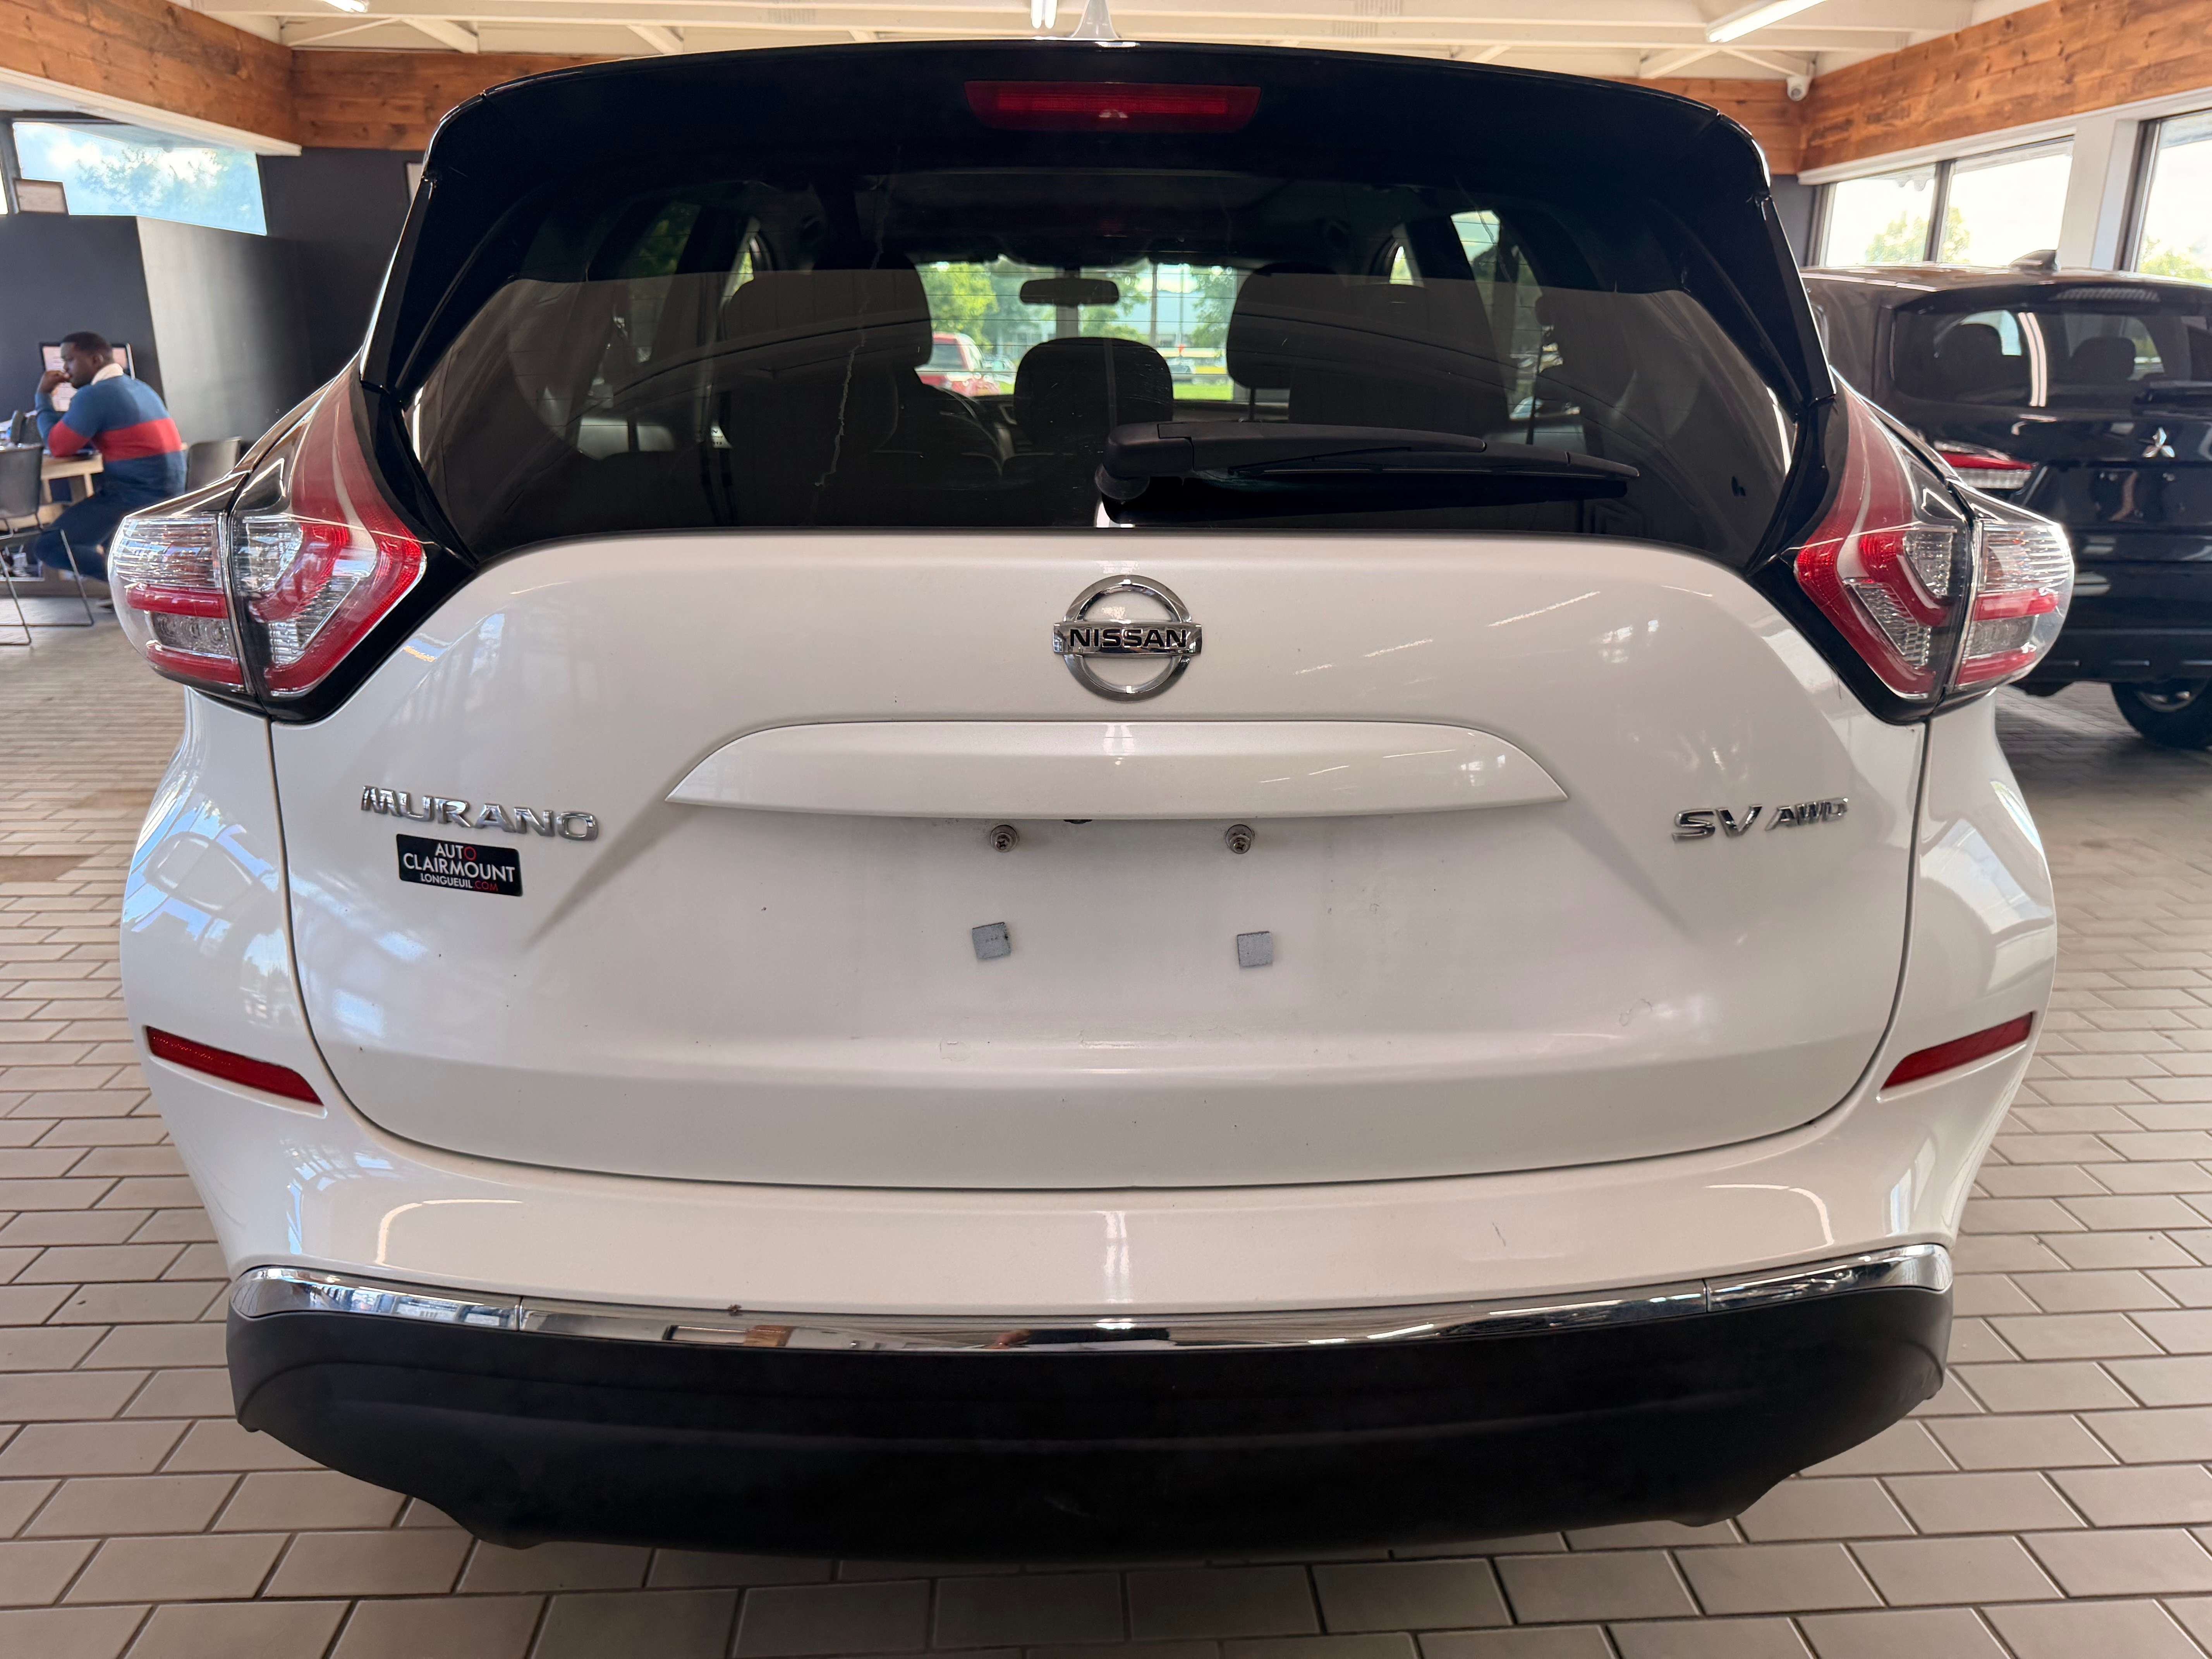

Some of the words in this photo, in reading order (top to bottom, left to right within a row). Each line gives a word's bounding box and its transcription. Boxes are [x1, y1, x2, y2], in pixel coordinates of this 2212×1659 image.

[1070, 628, 1187, 647] NISSAN
[361, 785, 599, 841] MURANO
[1671, 804, 1763, 843] SV
[1764, 797, 1849, 831] AWD
[434, 843, 477, 861] AUTO
[403, 853, 515, 882] CLAIRMOUNT
[420, 872, 498, 891] LONGUEUIL.COM
